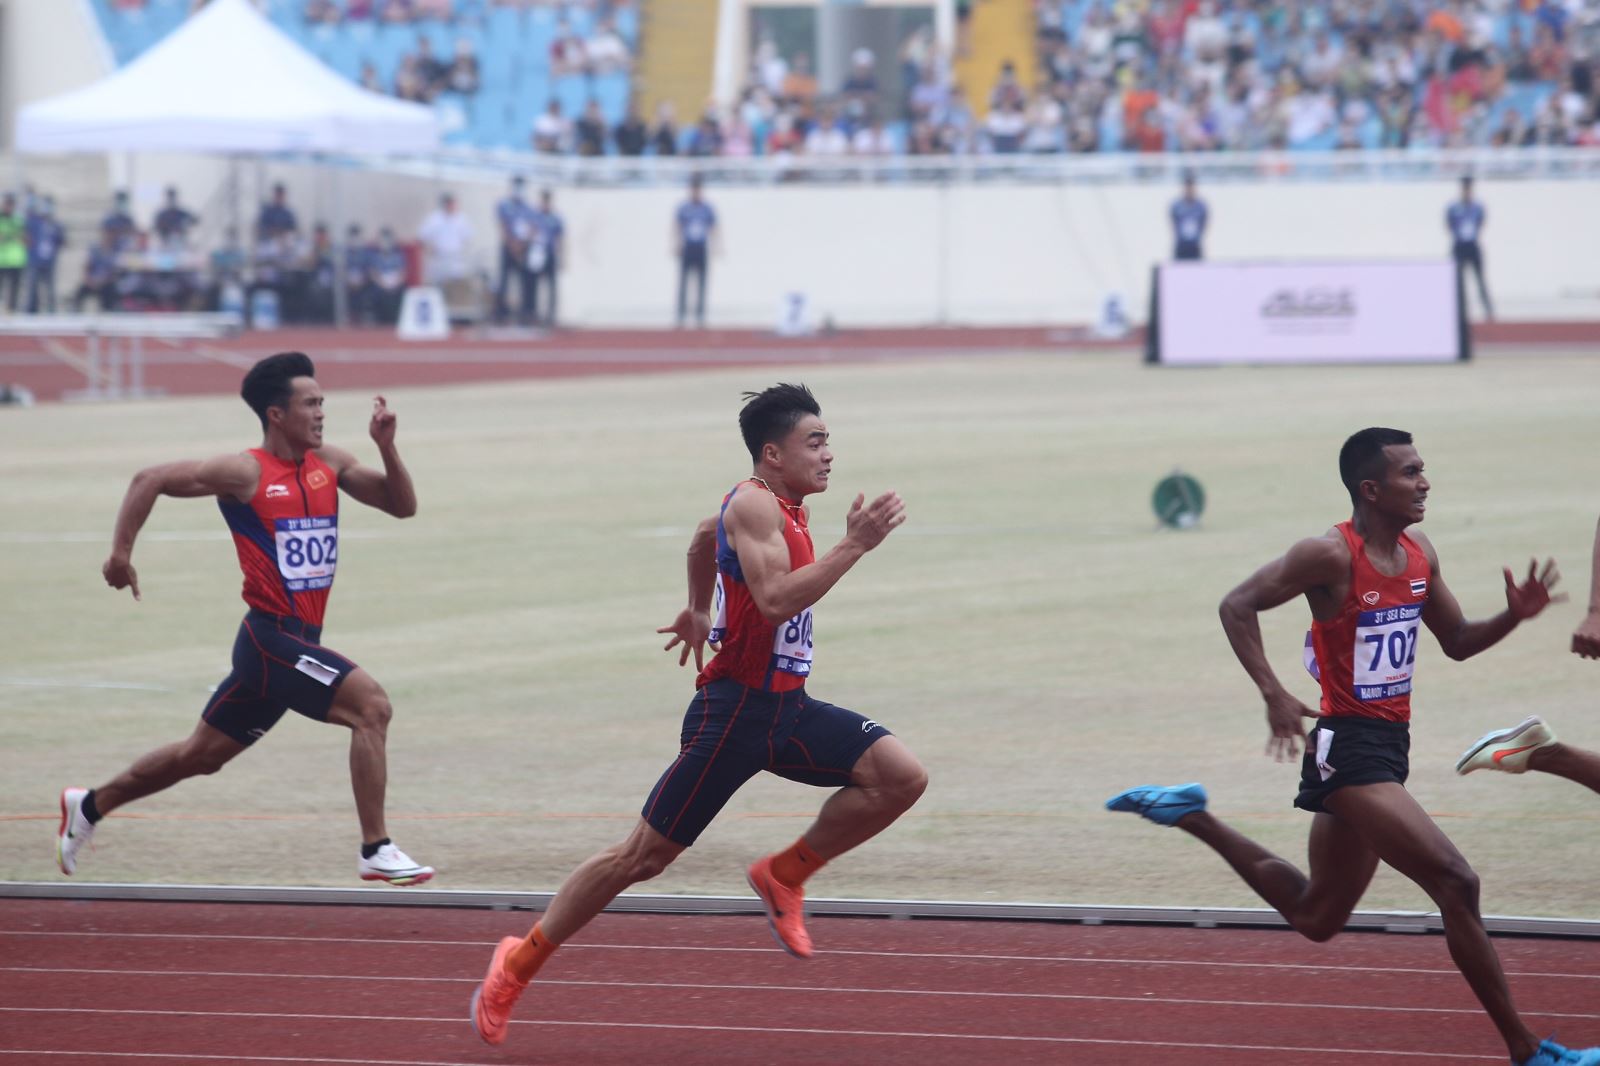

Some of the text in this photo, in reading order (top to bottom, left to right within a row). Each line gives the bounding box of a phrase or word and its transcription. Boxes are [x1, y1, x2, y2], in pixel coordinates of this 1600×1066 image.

[285, 535, 336, 568] 802
[1387, 609, 1399, 621] SEA
[1364, 626, 1417, 672] 702
